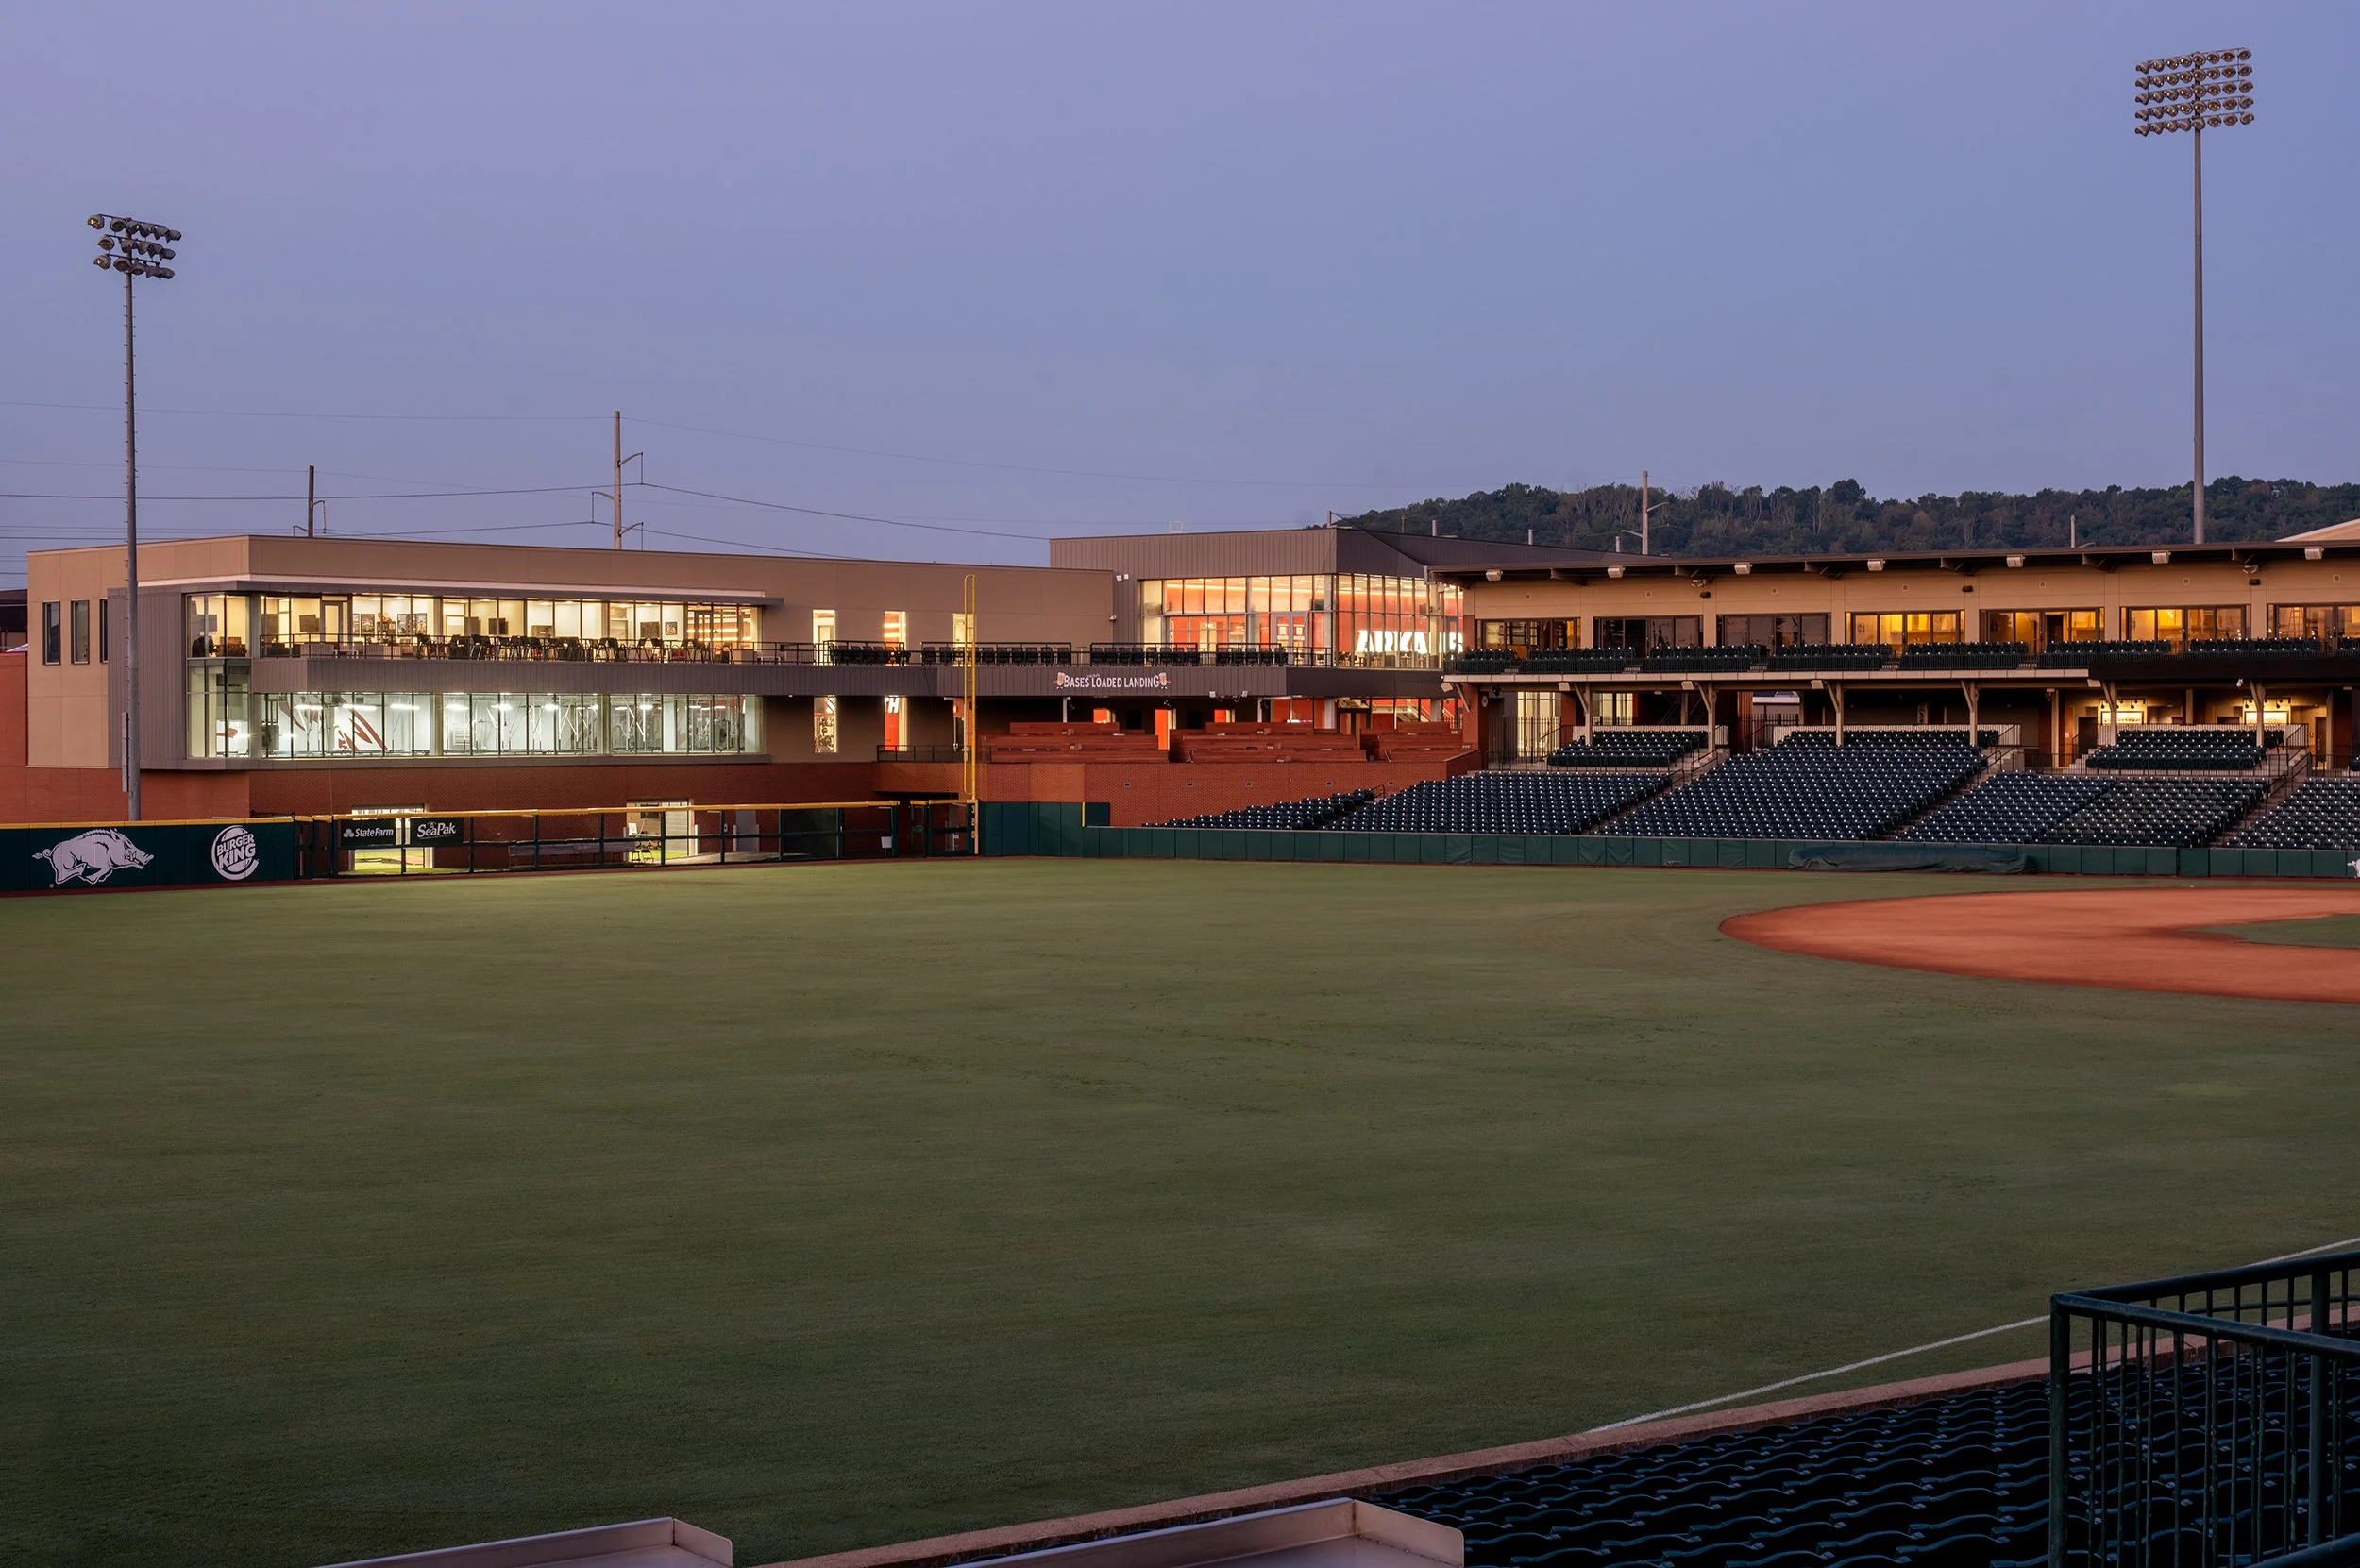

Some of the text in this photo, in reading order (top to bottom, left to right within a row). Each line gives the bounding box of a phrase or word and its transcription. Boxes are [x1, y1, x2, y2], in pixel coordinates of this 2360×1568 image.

[1064, 675, 1159, 687] BASES LOADED LANDING
[417, 822, 456, 837] SeaPak
[217, 834, 254, 856] BURGER
[218, 843, 256, 869] KING
